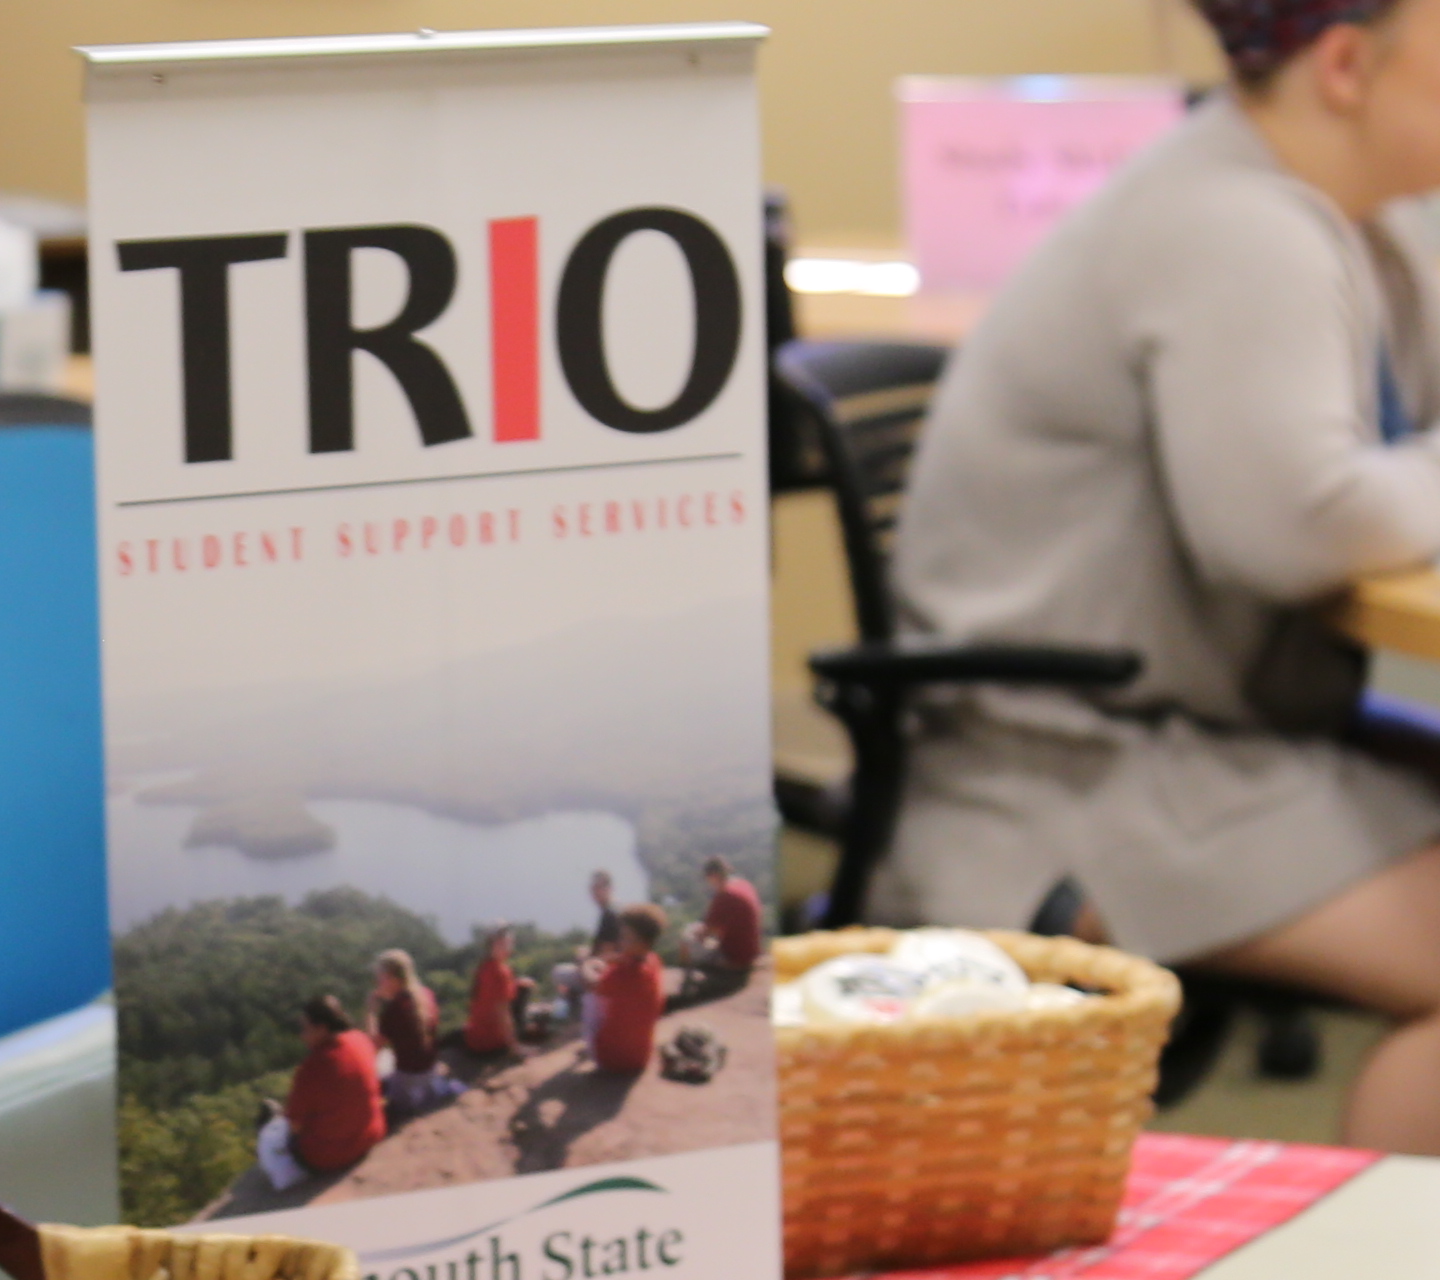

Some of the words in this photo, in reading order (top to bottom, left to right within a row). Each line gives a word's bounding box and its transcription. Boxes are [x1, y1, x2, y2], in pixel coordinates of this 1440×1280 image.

[114, 205, 744, 464] TRIO
[117, 526, 303, 576] STUDENT
[336, 508, 522, 558] SUPPORT
[552, 489, 747, 539] SERVICES
